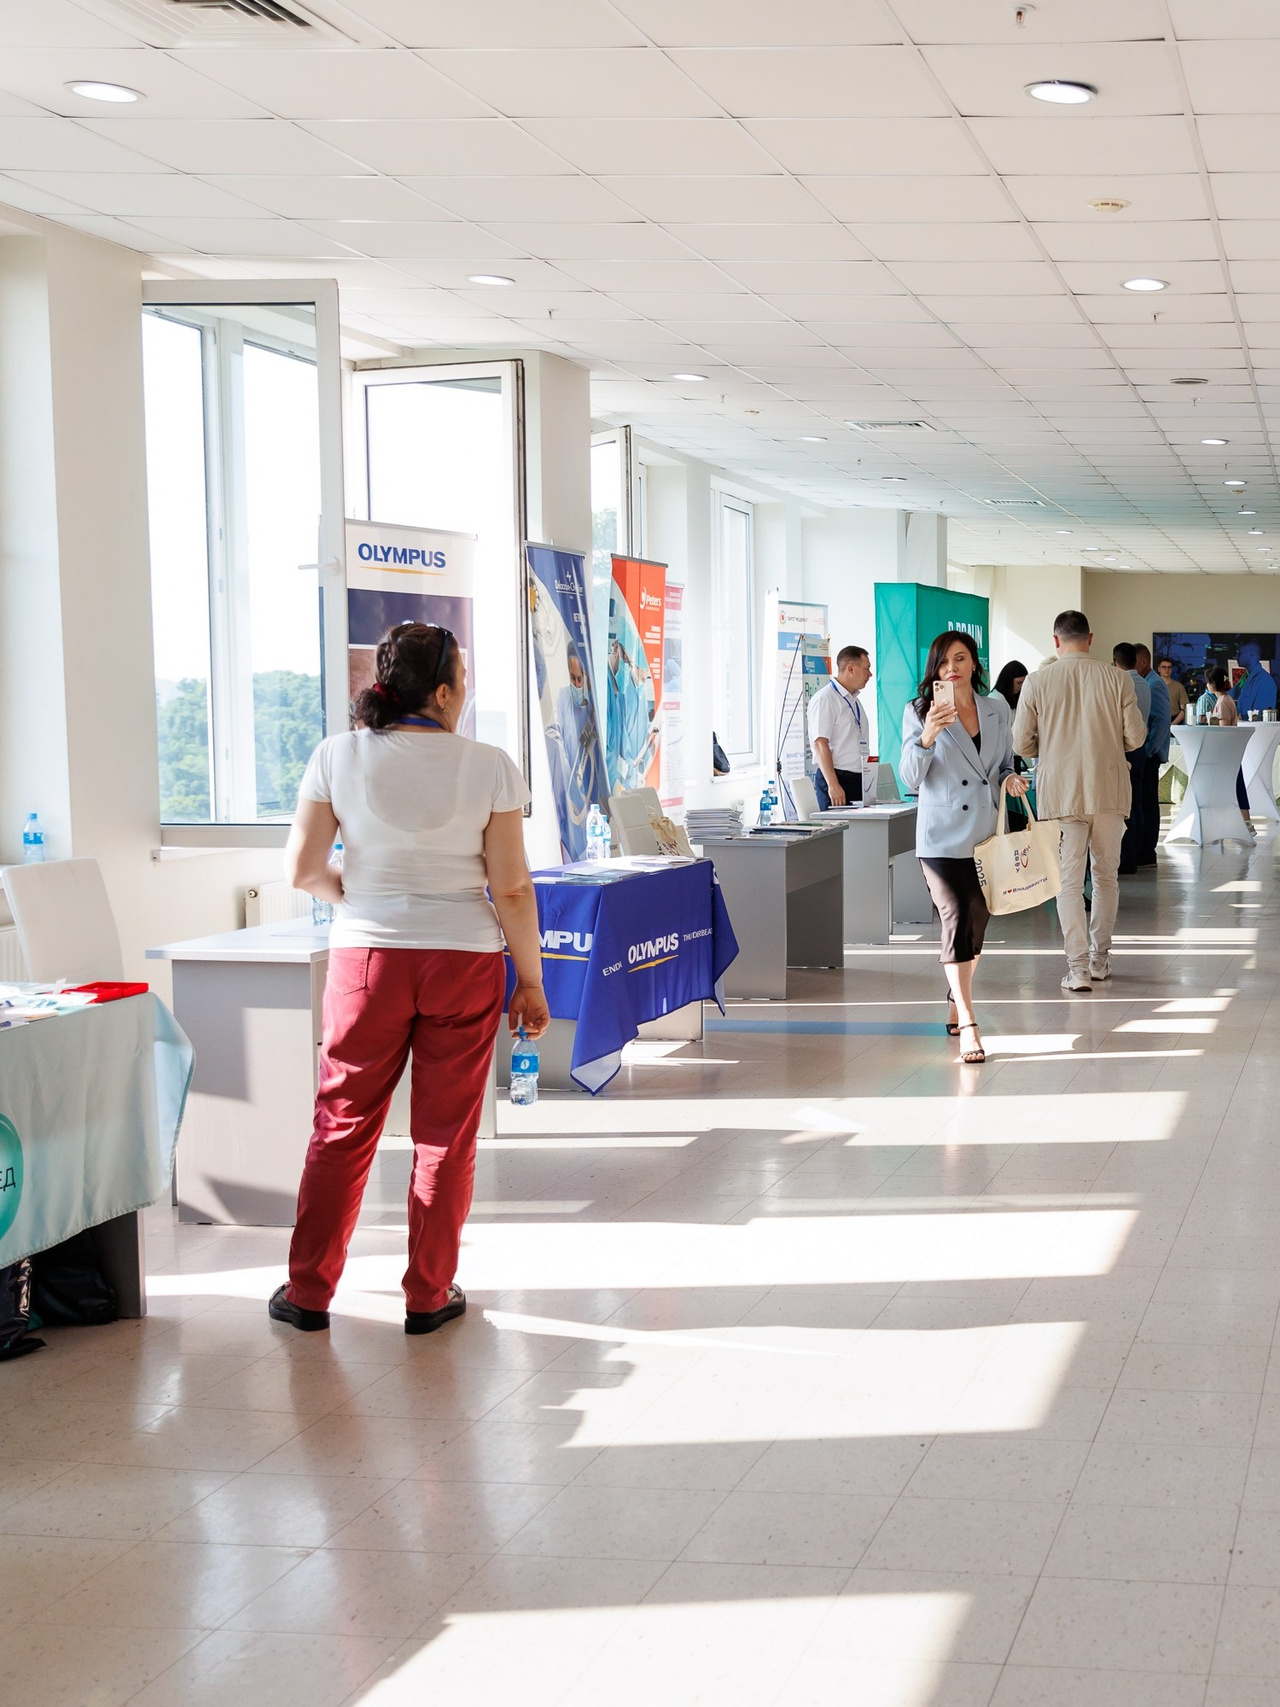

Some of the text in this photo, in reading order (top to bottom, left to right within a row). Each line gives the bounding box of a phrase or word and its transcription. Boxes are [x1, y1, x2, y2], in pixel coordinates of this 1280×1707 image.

[358, 543, 446, 568] OLYMPUS
[646, 595, 661, 607] Peters
[628, 932, 679, 965] OLYMPUS
